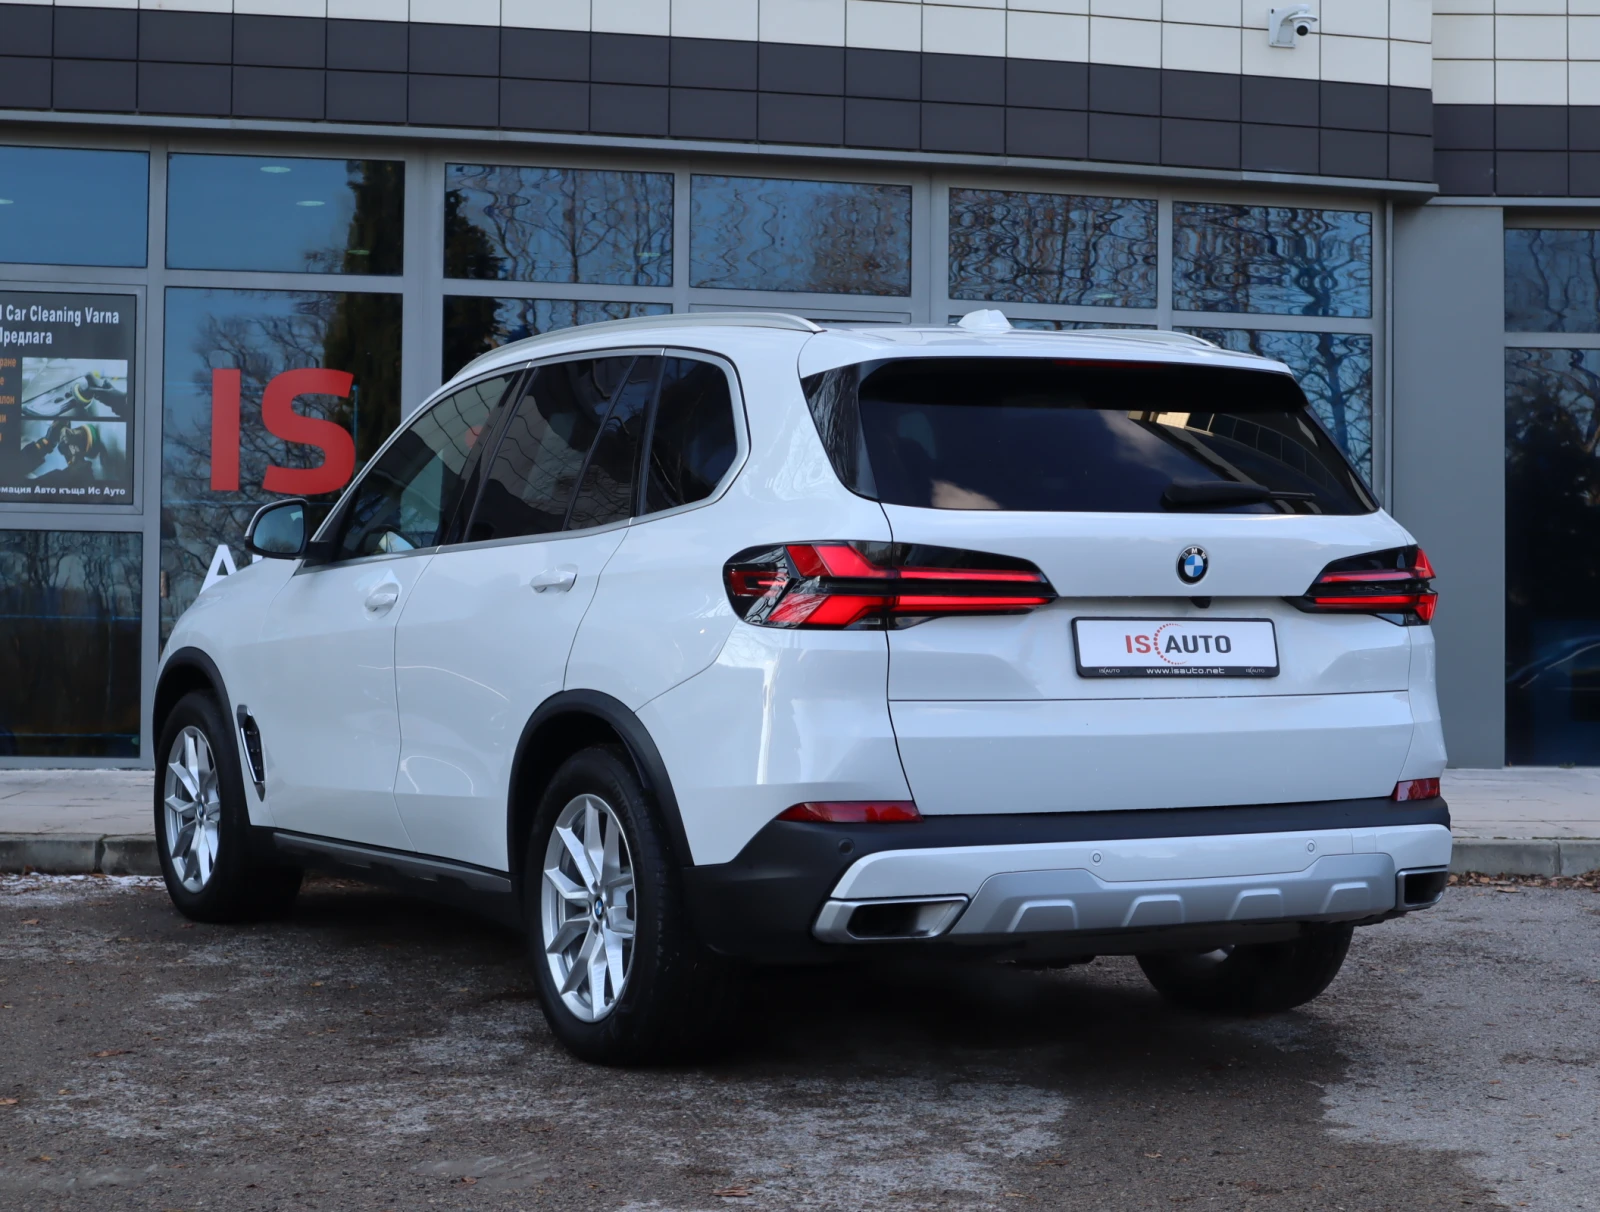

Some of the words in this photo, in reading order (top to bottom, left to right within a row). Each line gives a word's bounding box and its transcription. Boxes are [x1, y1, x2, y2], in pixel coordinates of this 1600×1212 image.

[6, 304, 27, 321] Car
[30, 305, 82, 327] Cleaning
[85, 307, 119, 324] Varna
[210, 368, 356, 495] IS
[34, 485, 57, 494] Авто
[59, 487, 86, 496] къща
[88, 486, 101, 495] Ис
[103, 487, 126, 497] Ауто
[1125, 634, 1152, 654] IS
[1165, 634, 1232, 654] AUTO
[1145, 667, 1225, 675] www.isauto.net
